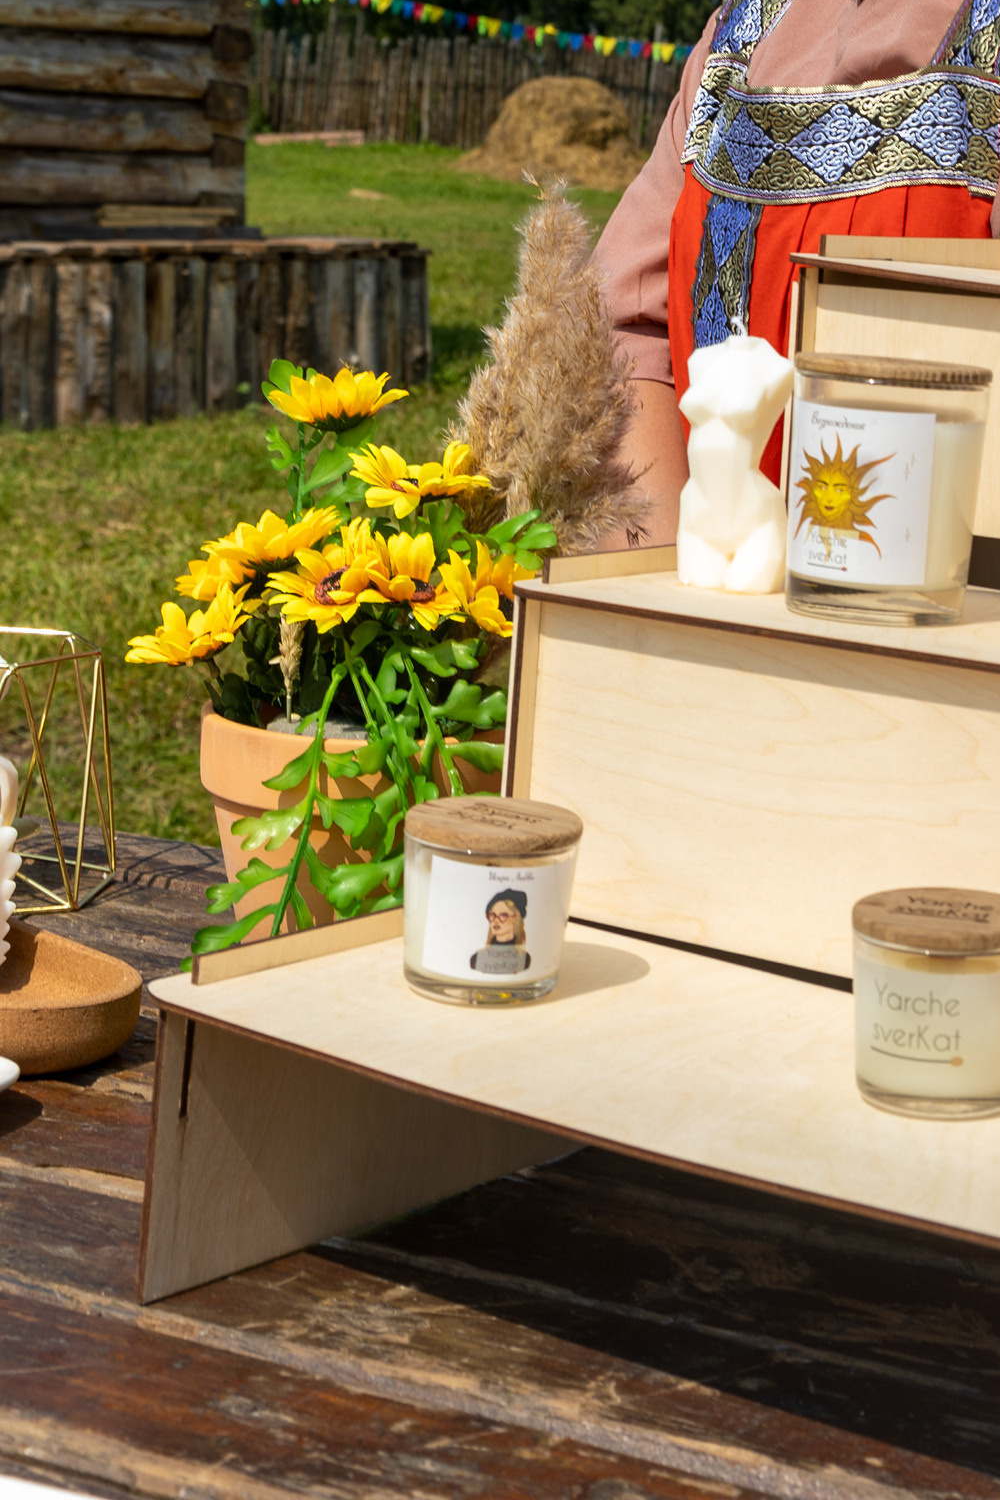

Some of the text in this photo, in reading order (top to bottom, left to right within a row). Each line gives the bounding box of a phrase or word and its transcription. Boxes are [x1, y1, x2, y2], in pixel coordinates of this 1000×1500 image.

[894, 905, 990, 920] sverKat
[906, 894, 994, 911] Yarche
[874, 979, 961, 1017] Yarche
[872, 1022, 962, 1052] sverKat
